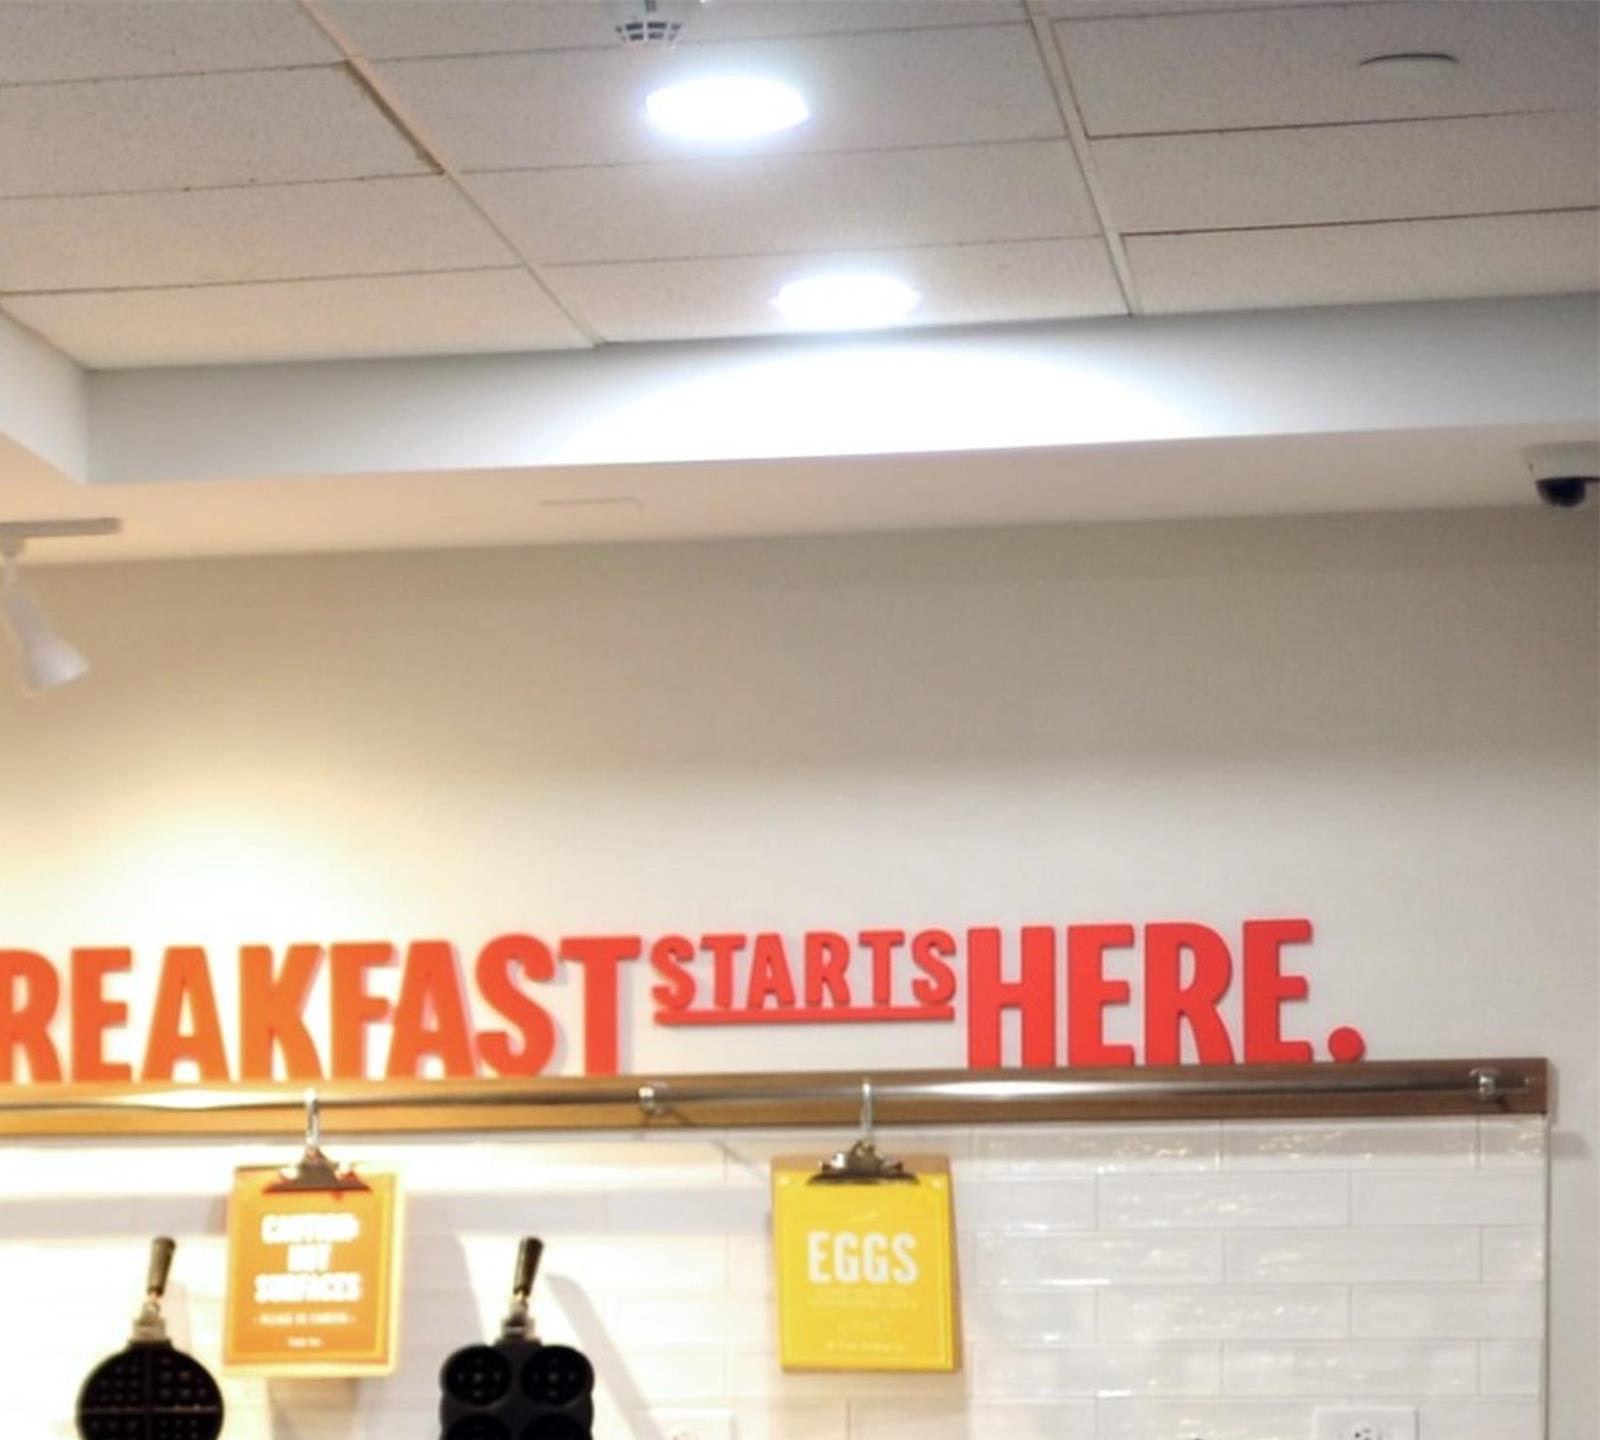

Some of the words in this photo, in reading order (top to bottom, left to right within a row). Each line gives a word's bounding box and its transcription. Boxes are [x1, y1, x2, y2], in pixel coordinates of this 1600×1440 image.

[650, 928, 957, 1012] STARTS
[966, 919, 1367, 1069] HERE.
[807, 1231, 919, 1285] EGGS
